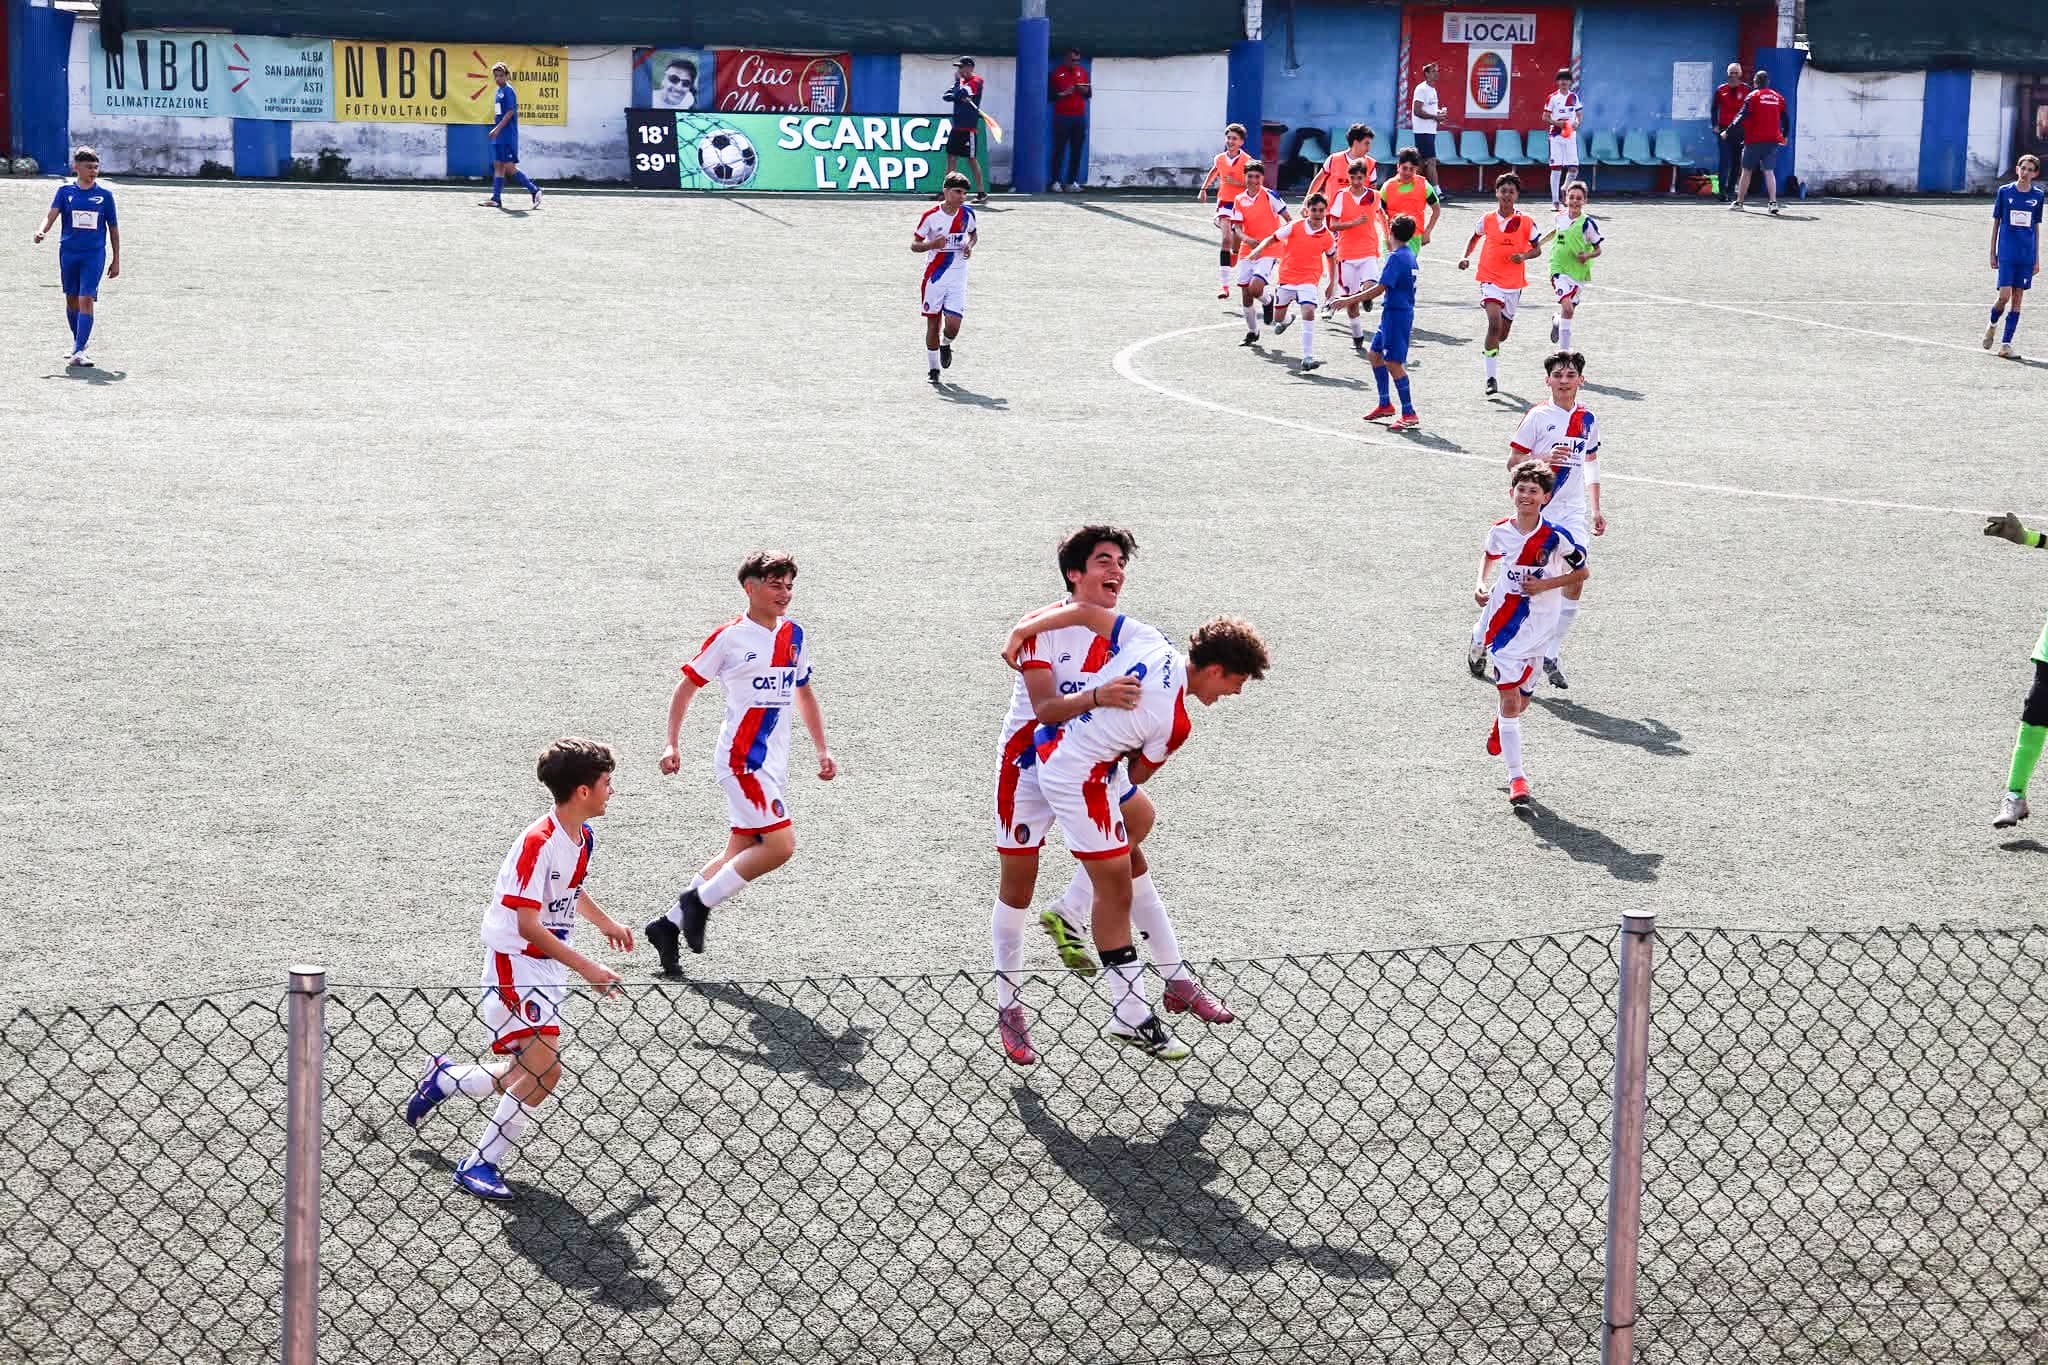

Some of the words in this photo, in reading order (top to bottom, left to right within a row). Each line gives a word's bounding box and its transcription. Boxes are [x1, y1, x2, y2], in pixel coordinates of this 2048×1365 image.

[1464, 23, 1534, 41] LOCALI
[301, 51, 323, 62] ALBA
[536, 55, 559, 67] ALBA
[106, 40, 209, 92] NIBO
[264, 65, 282, 76] SAN
[284, 65, 324, 78] DAMIANO
[345, 46, 447, 100] NIBO
[736, 54, 793, 87] Ciao
[519, 71, 560, 82] DAMIANO
[303, 82, 323, 93] ASTI
[539, 87, 560, 98] ASTI
[106, 95, 209, 109] CLIMATIZZAZIONE
[345, 103, 448, 117] FOTOVOLTAICO
[638, 125, 669, 145] 18'
[777, 115, 953, 151] SCARICA
